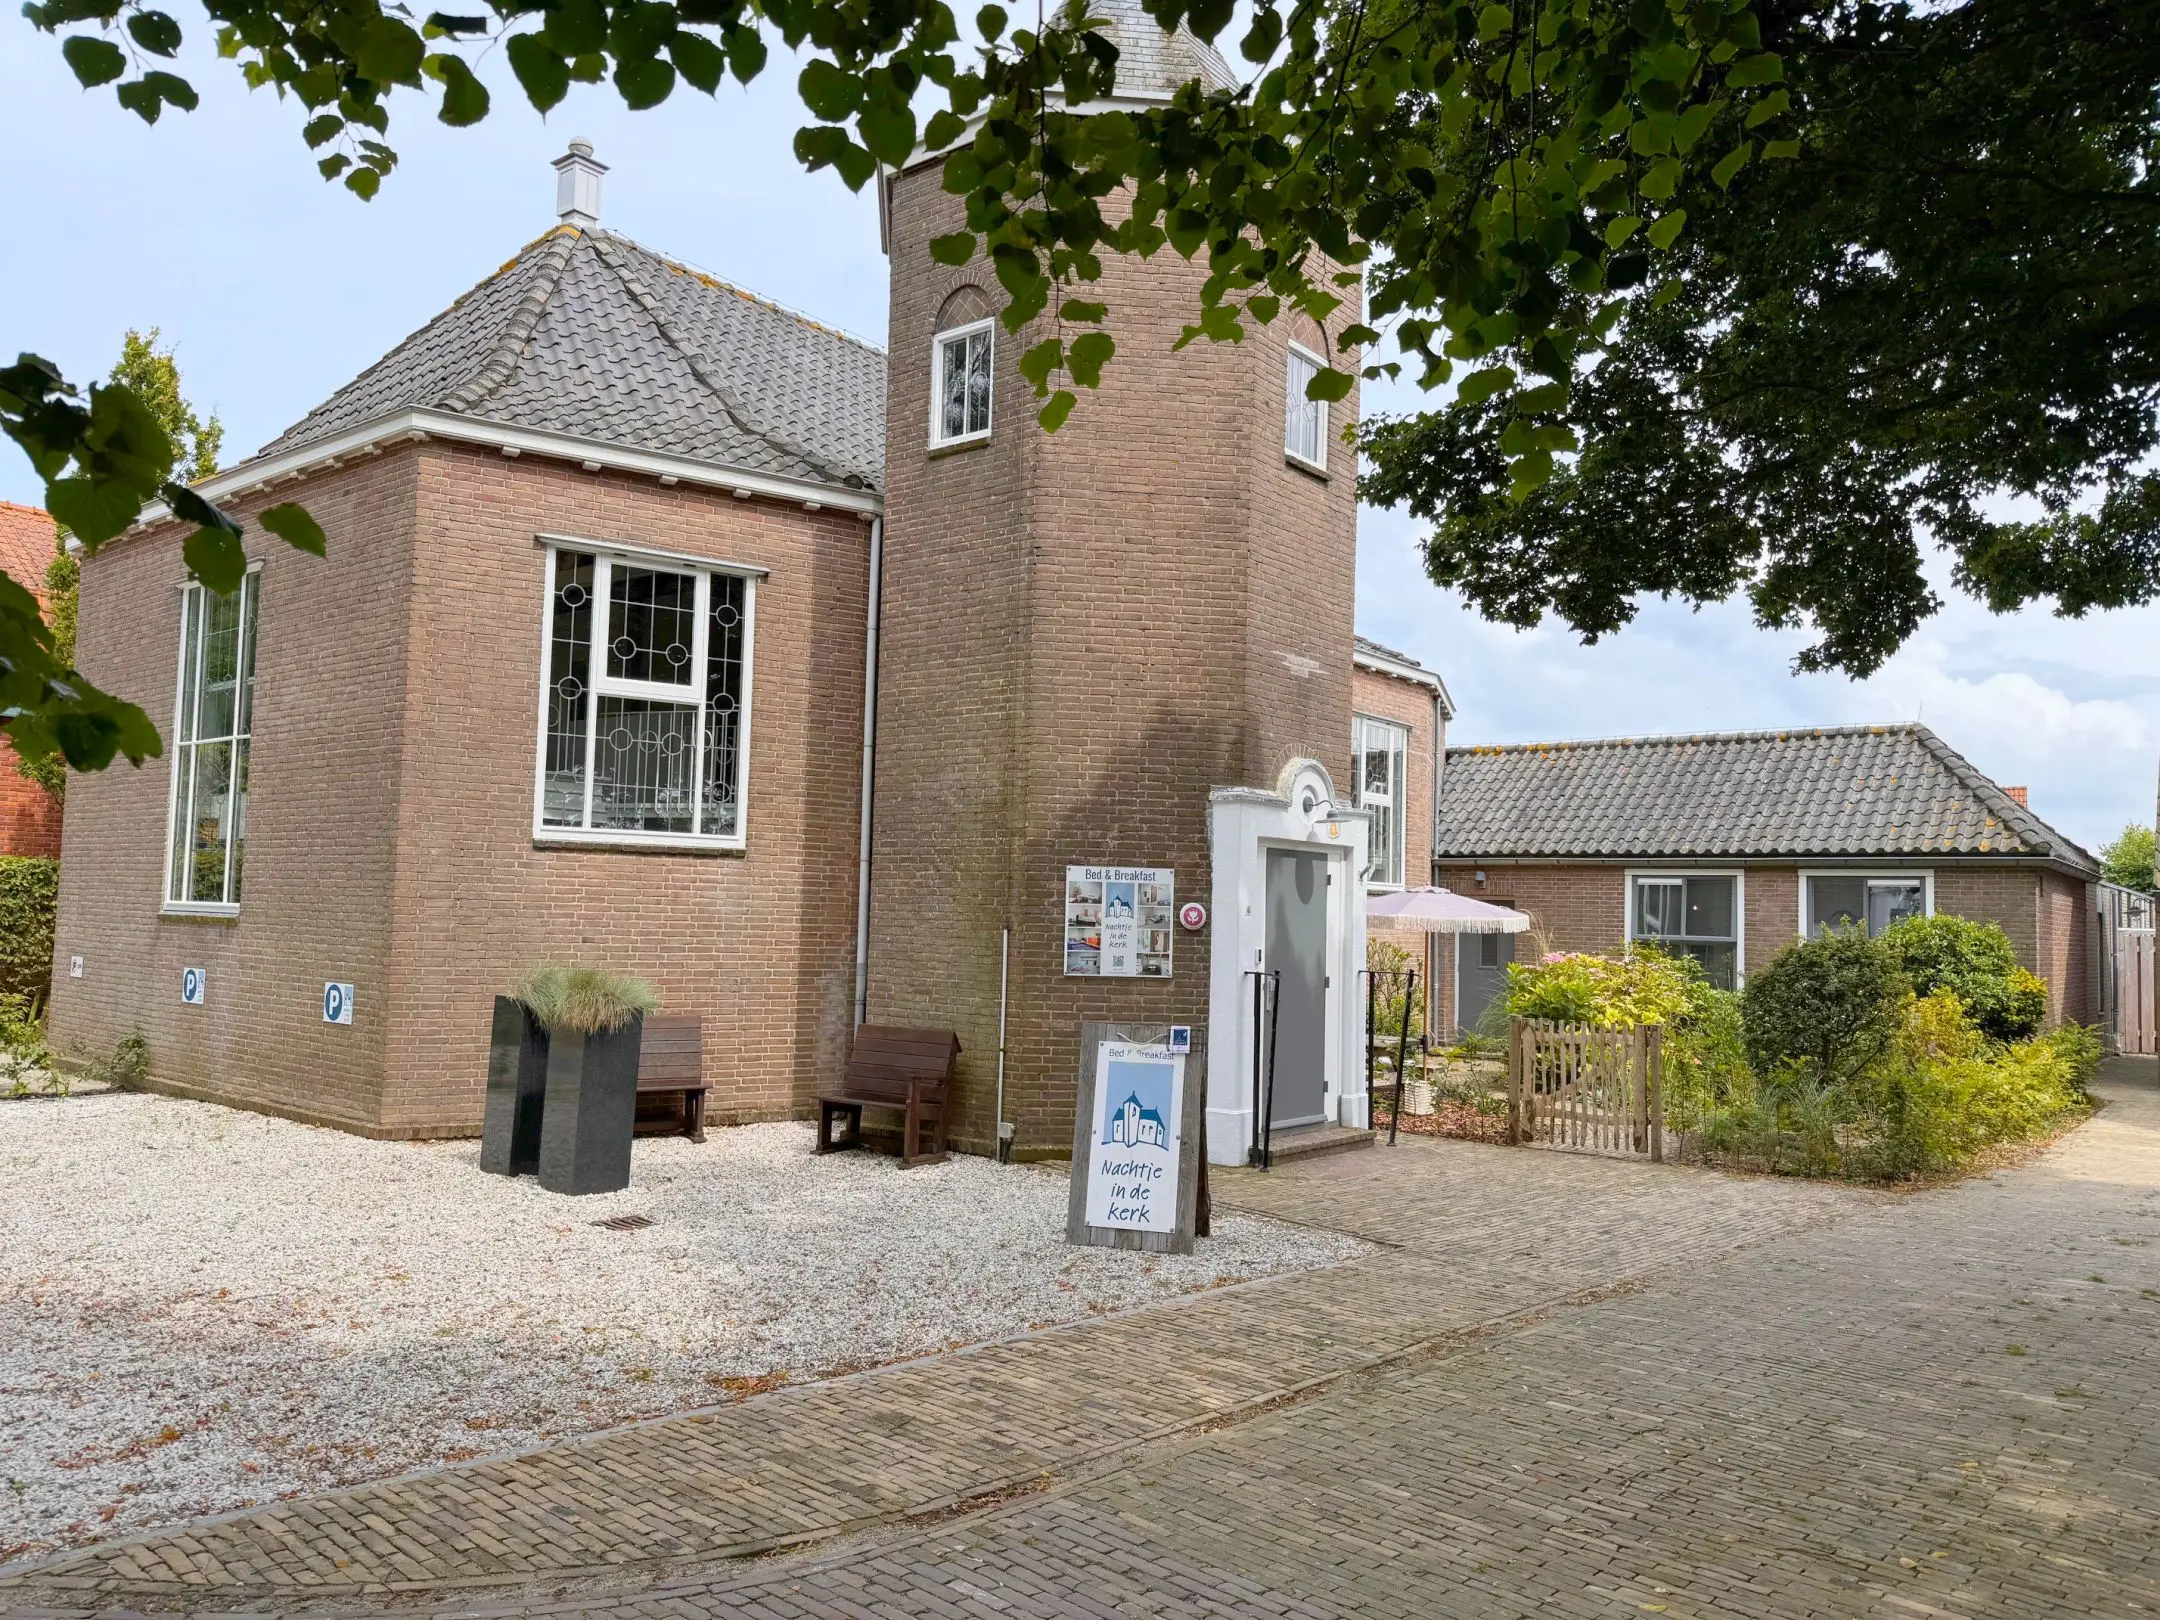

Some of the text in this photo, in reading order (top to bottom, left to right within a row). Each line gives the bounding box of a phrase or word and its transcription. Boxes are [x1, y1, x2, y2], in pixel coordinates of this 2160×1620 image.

[1085, 868, 1156, 881] Bed & Breakfast
[186, 973, 195, 997] P
[328, 989, 340, 1016] P
[1109, 1048, 1125, 1058] Bed
[1101, 1159, 1163, 1182] Nachtje
[1111, 1182, 1151, 1200] in de
[1107, 1201, 1150, 1223] kerk
